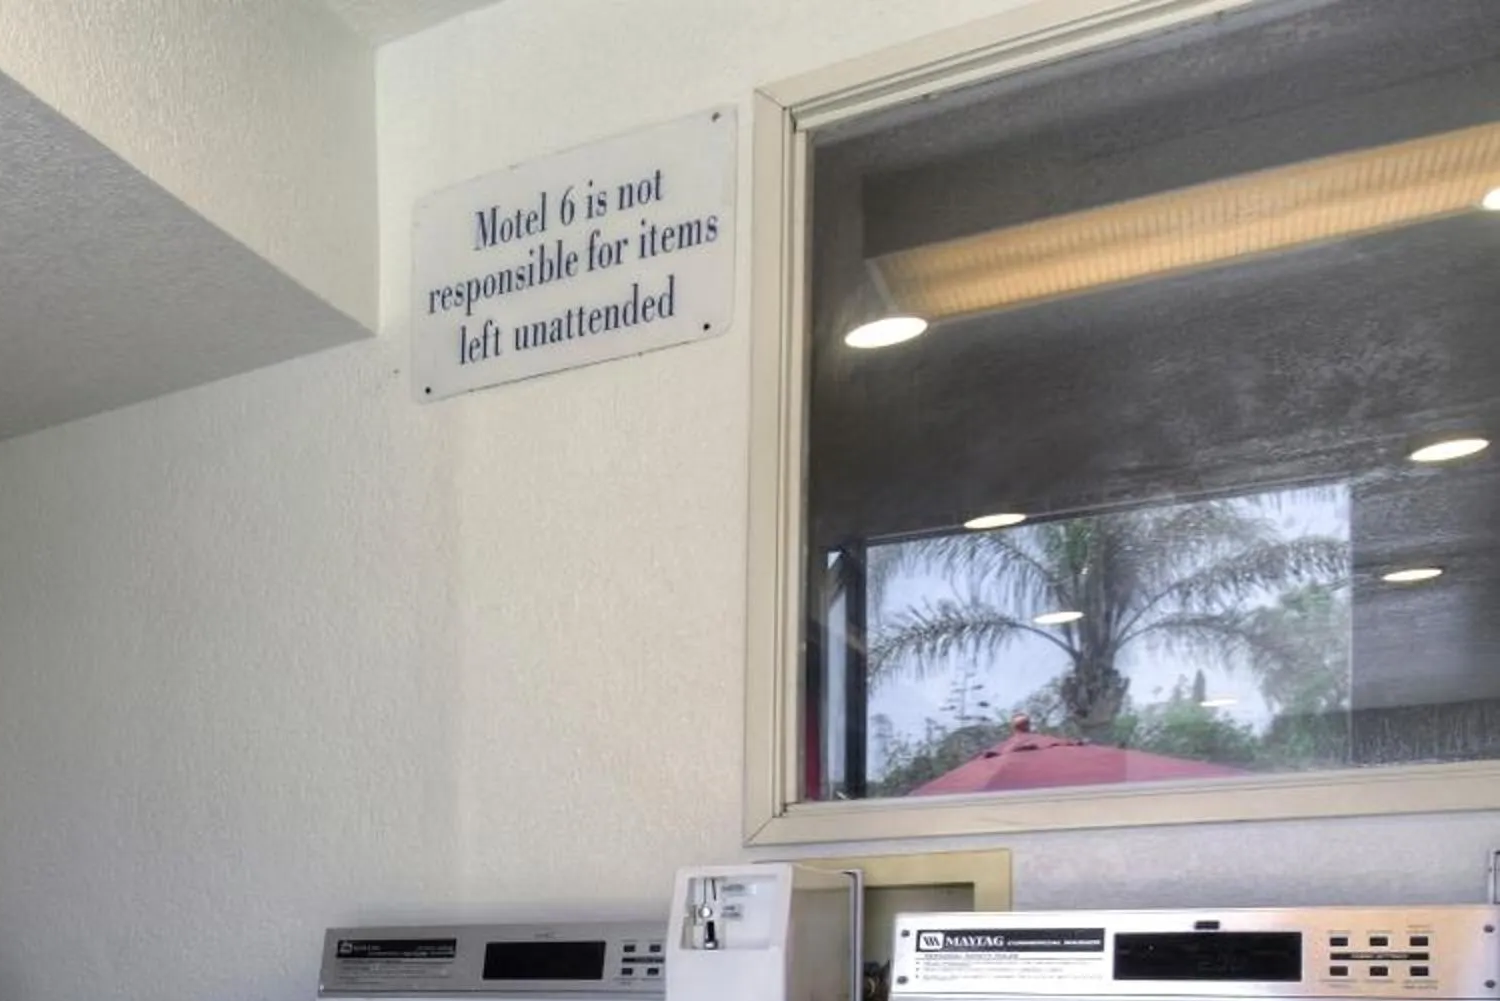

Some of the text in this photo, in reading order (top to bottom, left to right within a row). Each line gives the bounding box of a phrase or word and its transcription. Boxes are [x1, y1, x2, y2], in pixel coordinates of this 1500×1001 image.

[473, 168, 665, 252] Motel 6 is not
[427, 213, 720, 317] responsible for items
[457, 274, 676, 366] left unattended
[945, 935, 1004, 947] MAYTAG
